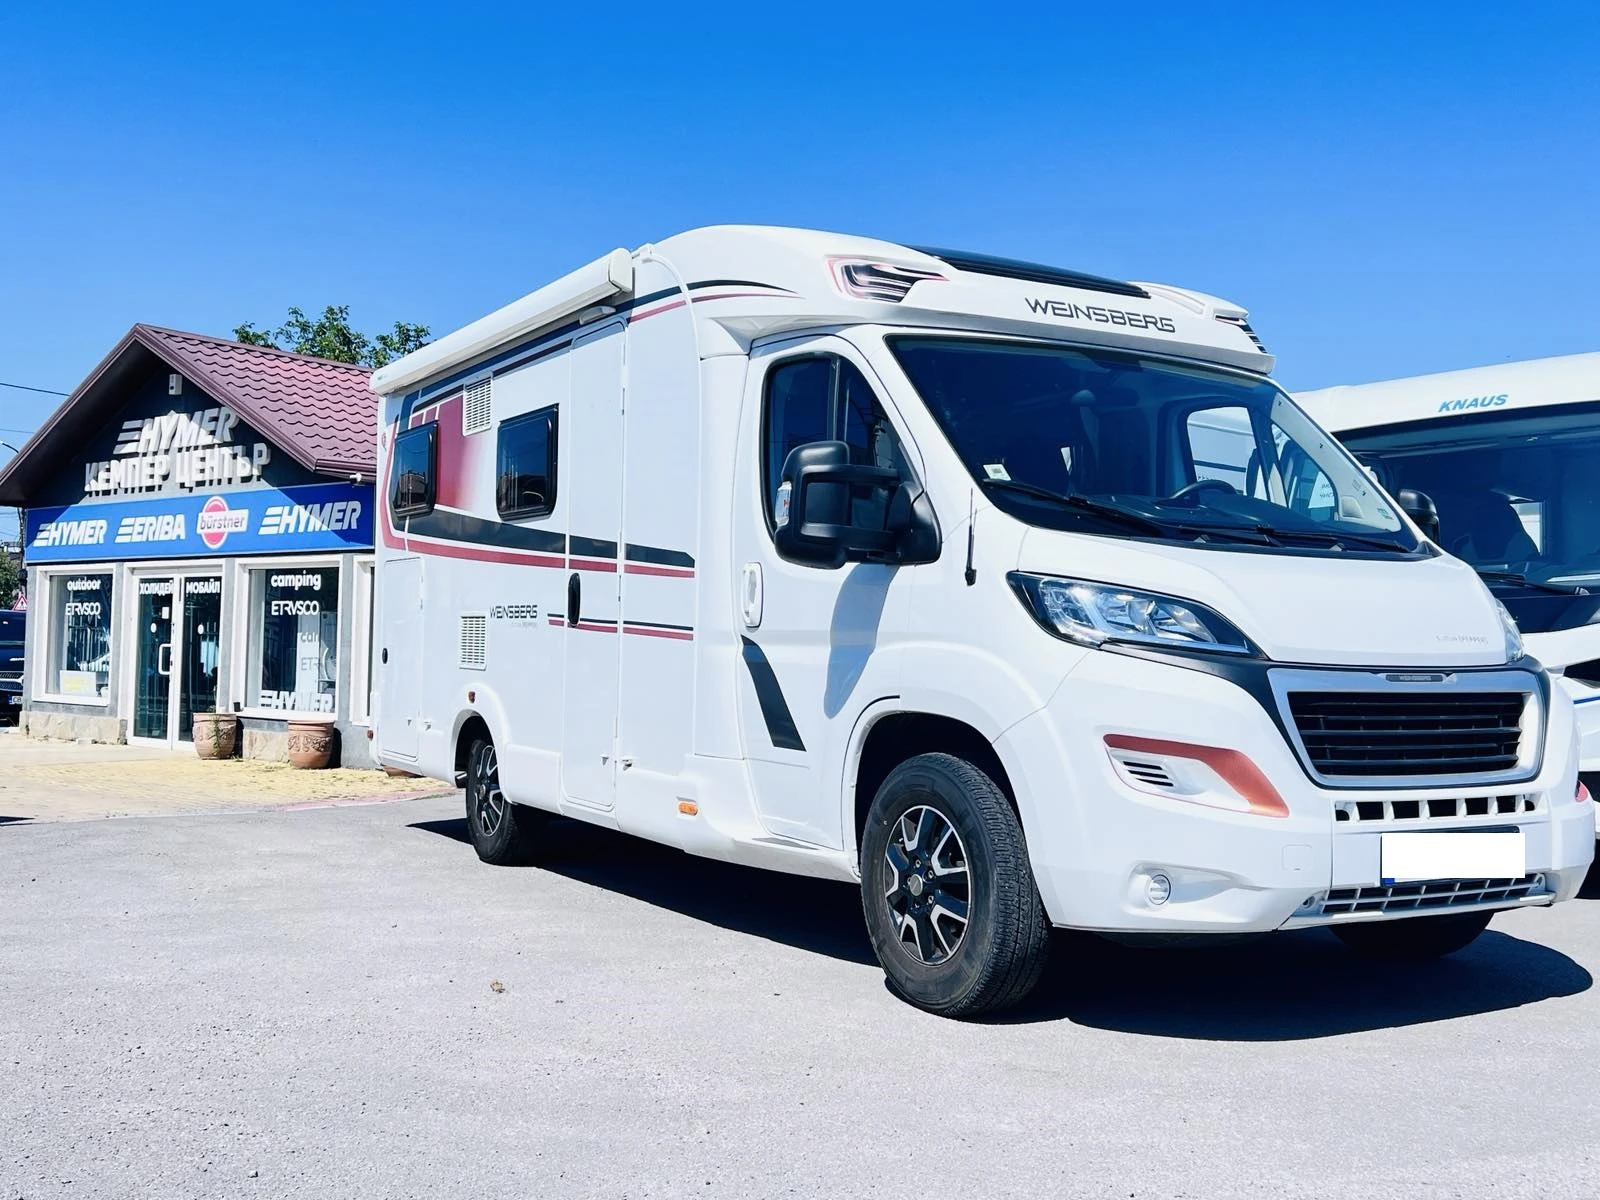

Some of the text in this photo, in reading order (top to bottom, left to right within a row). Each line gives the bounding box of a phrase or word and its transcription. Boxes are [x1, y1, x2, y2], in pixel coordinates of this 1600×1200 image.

[1025, 297, 1176, 333] WEINSBERG
[1438, 394, 1509, 413] KNAUS
[135, 406, 240, 453] HYMER
[84, 442, 271, 492] КЕМПЕР ЦЕНТЪР
[129, 513, 186, 543] ERIBA
[200, 512, 246, 530] bürstner
[277, 500, 362, 535] HYMER
[46, 519, 108, 547] HYMER
[67, 576, 101, 591] outdoor
[140, 579, 174, 596] ХОЛИДЕЙ
[186, 578, 221, 594] МОБАЙЛ
[271, 570, 321, 591] camping
[490, 604, 538, 619] WEINSBERG
